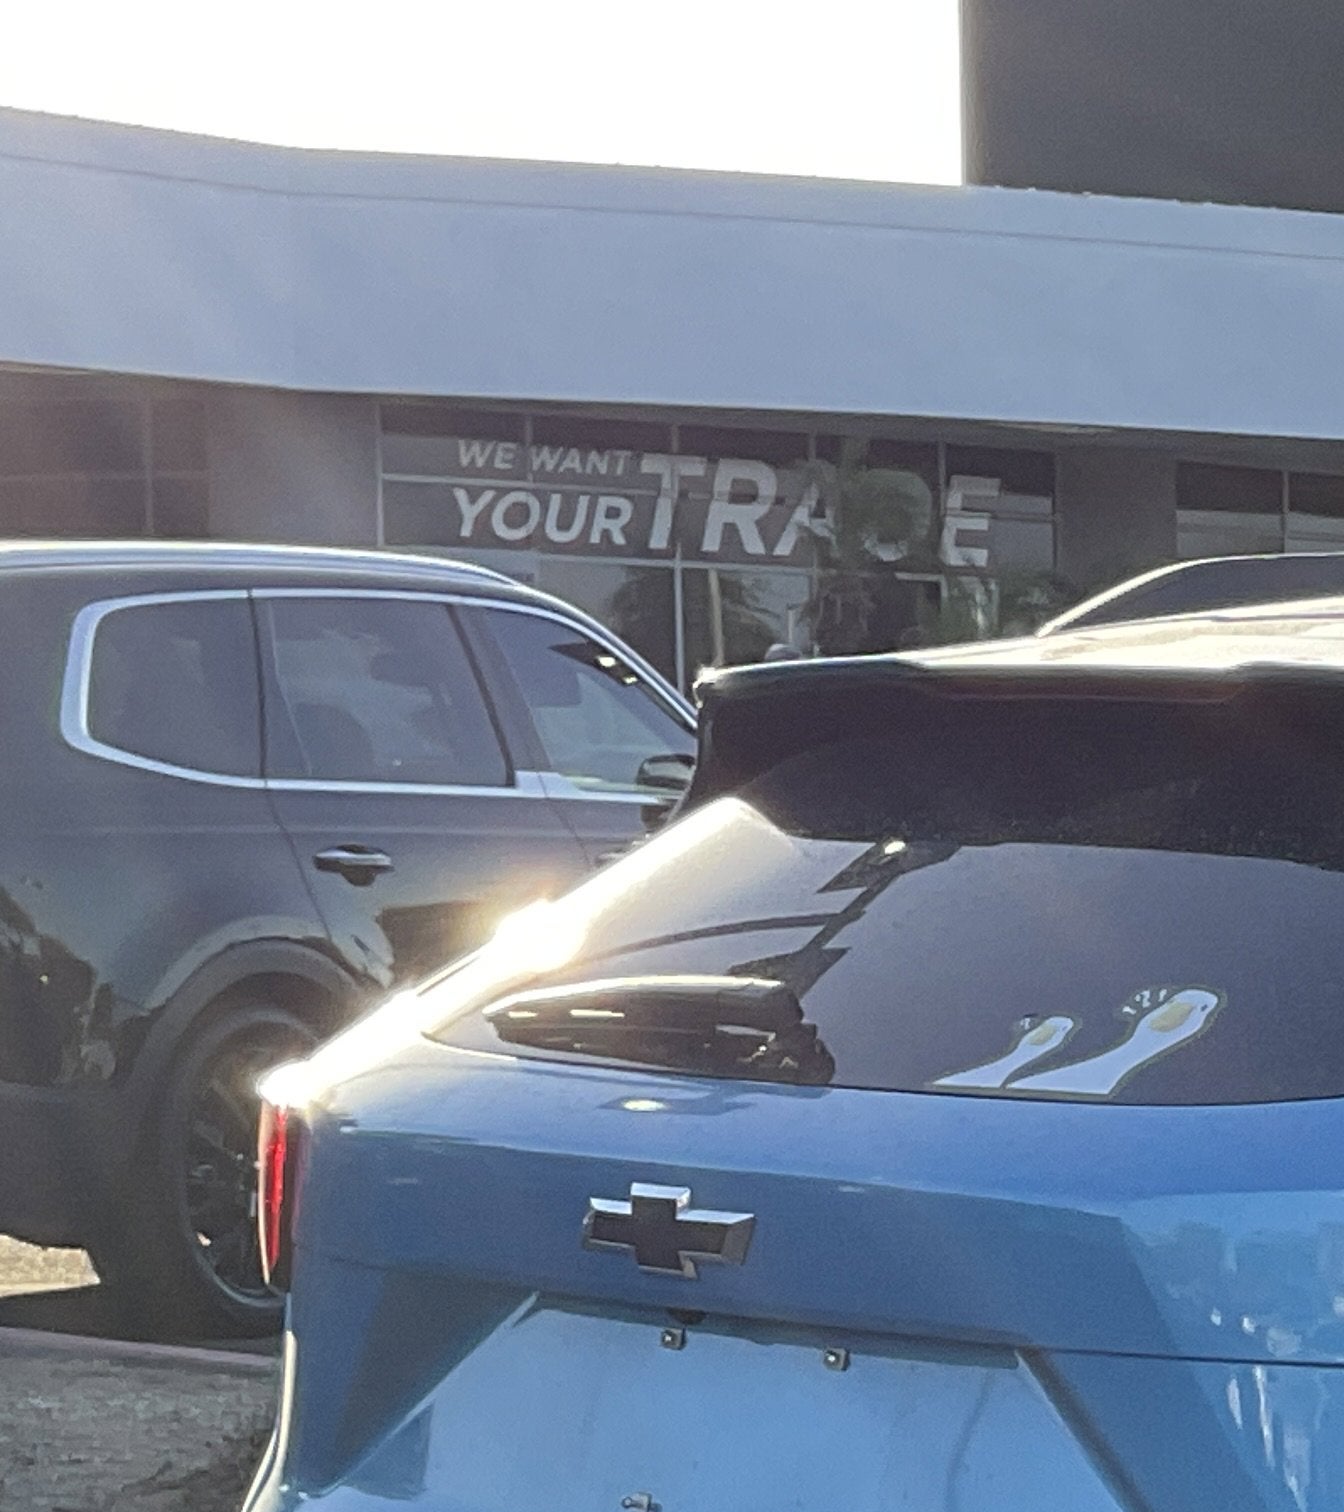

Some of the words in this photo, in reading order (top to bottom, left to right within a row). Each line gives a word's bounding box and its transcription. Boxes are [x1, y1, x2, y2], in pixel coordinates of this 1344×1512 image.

[458, 439, 520, 470] WE
[530, 445, 632, 475] WANT
[453, 487, 633, 545] YOUR
